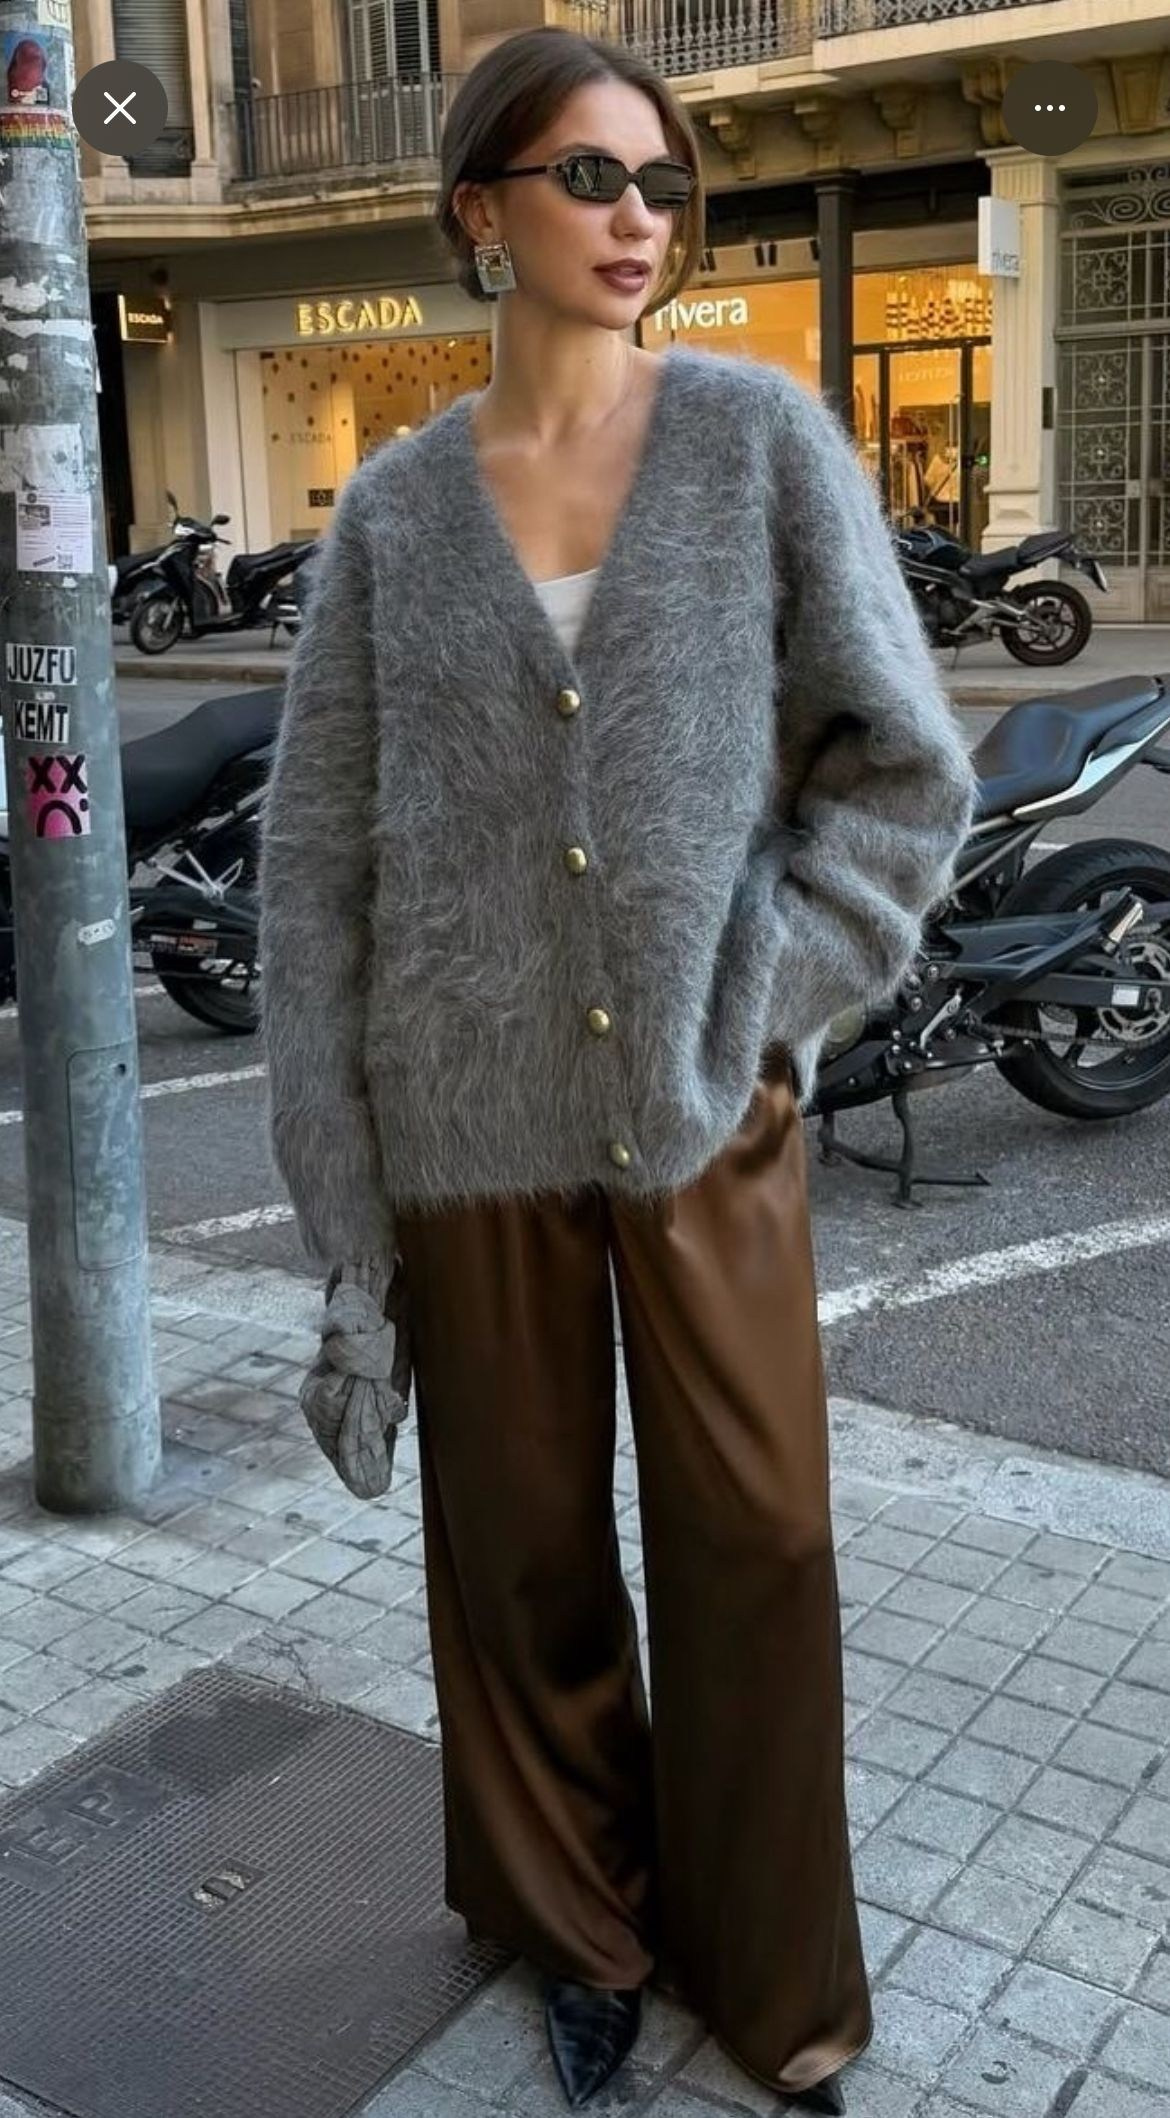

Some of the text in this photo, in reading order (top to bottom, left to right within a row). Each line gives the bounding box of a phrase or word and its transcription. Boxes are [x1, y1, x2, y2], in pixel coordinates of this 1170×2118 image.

[297, 297, 423, 335] ESCADA
[655, 298, 748, 331] rivera
[8, 646, 75, 684] JUZFU
[14, 702, 68, 742] KEMT
